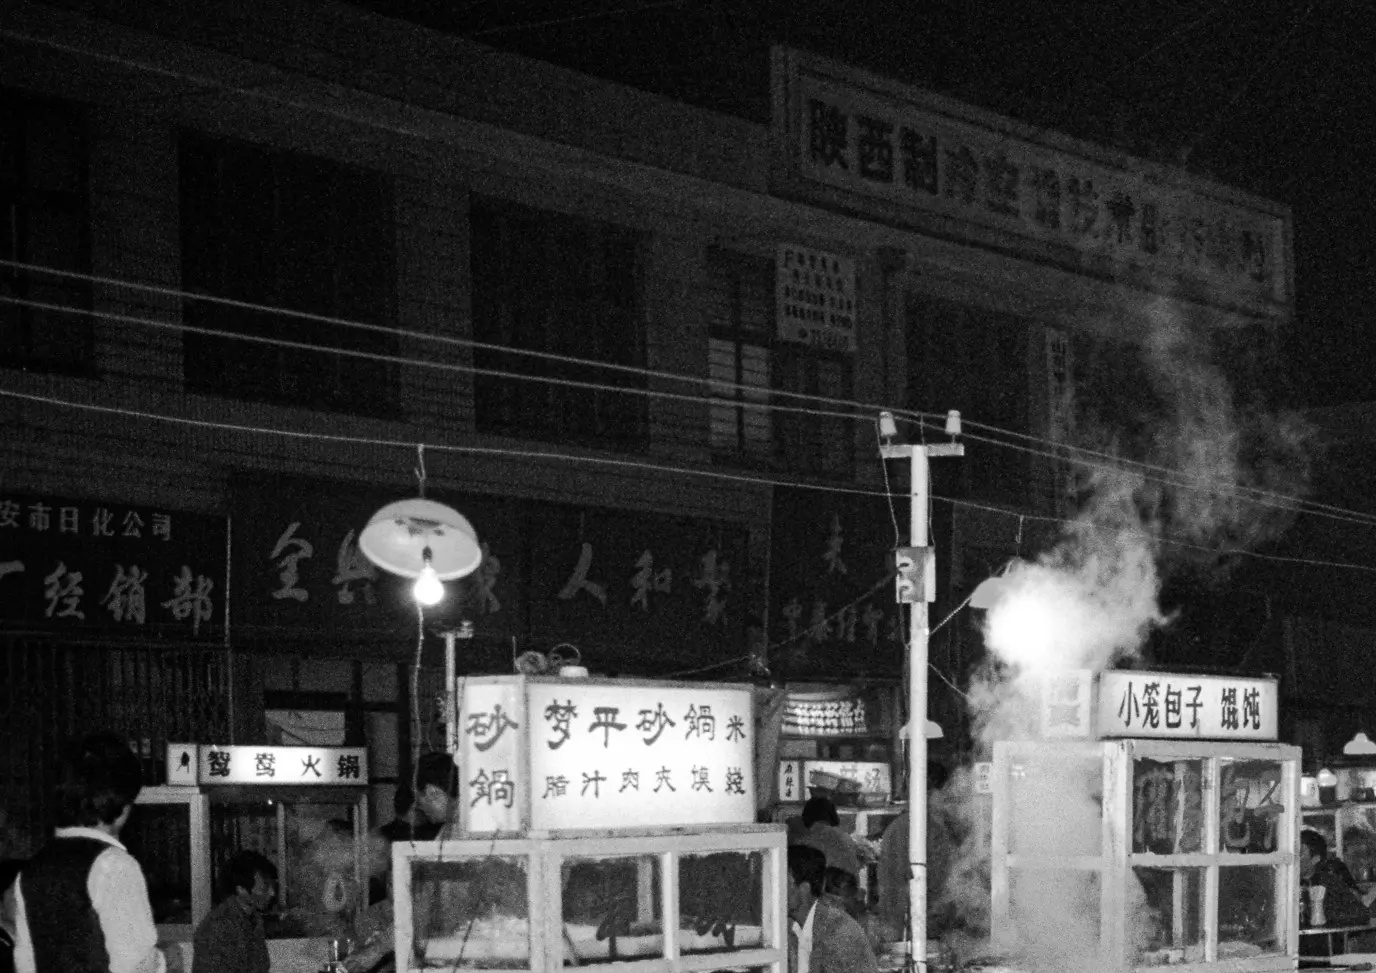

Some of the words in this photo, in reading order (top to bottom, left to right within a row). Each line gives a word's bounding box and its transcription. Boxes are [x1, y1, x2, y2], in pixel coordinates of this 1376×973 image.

[1118, 681, 1203, 729] 小笼包子
[1220, 687, 1261, 731] 馄饨
[208, 750, 360, 779] 鸳鸯火锅
